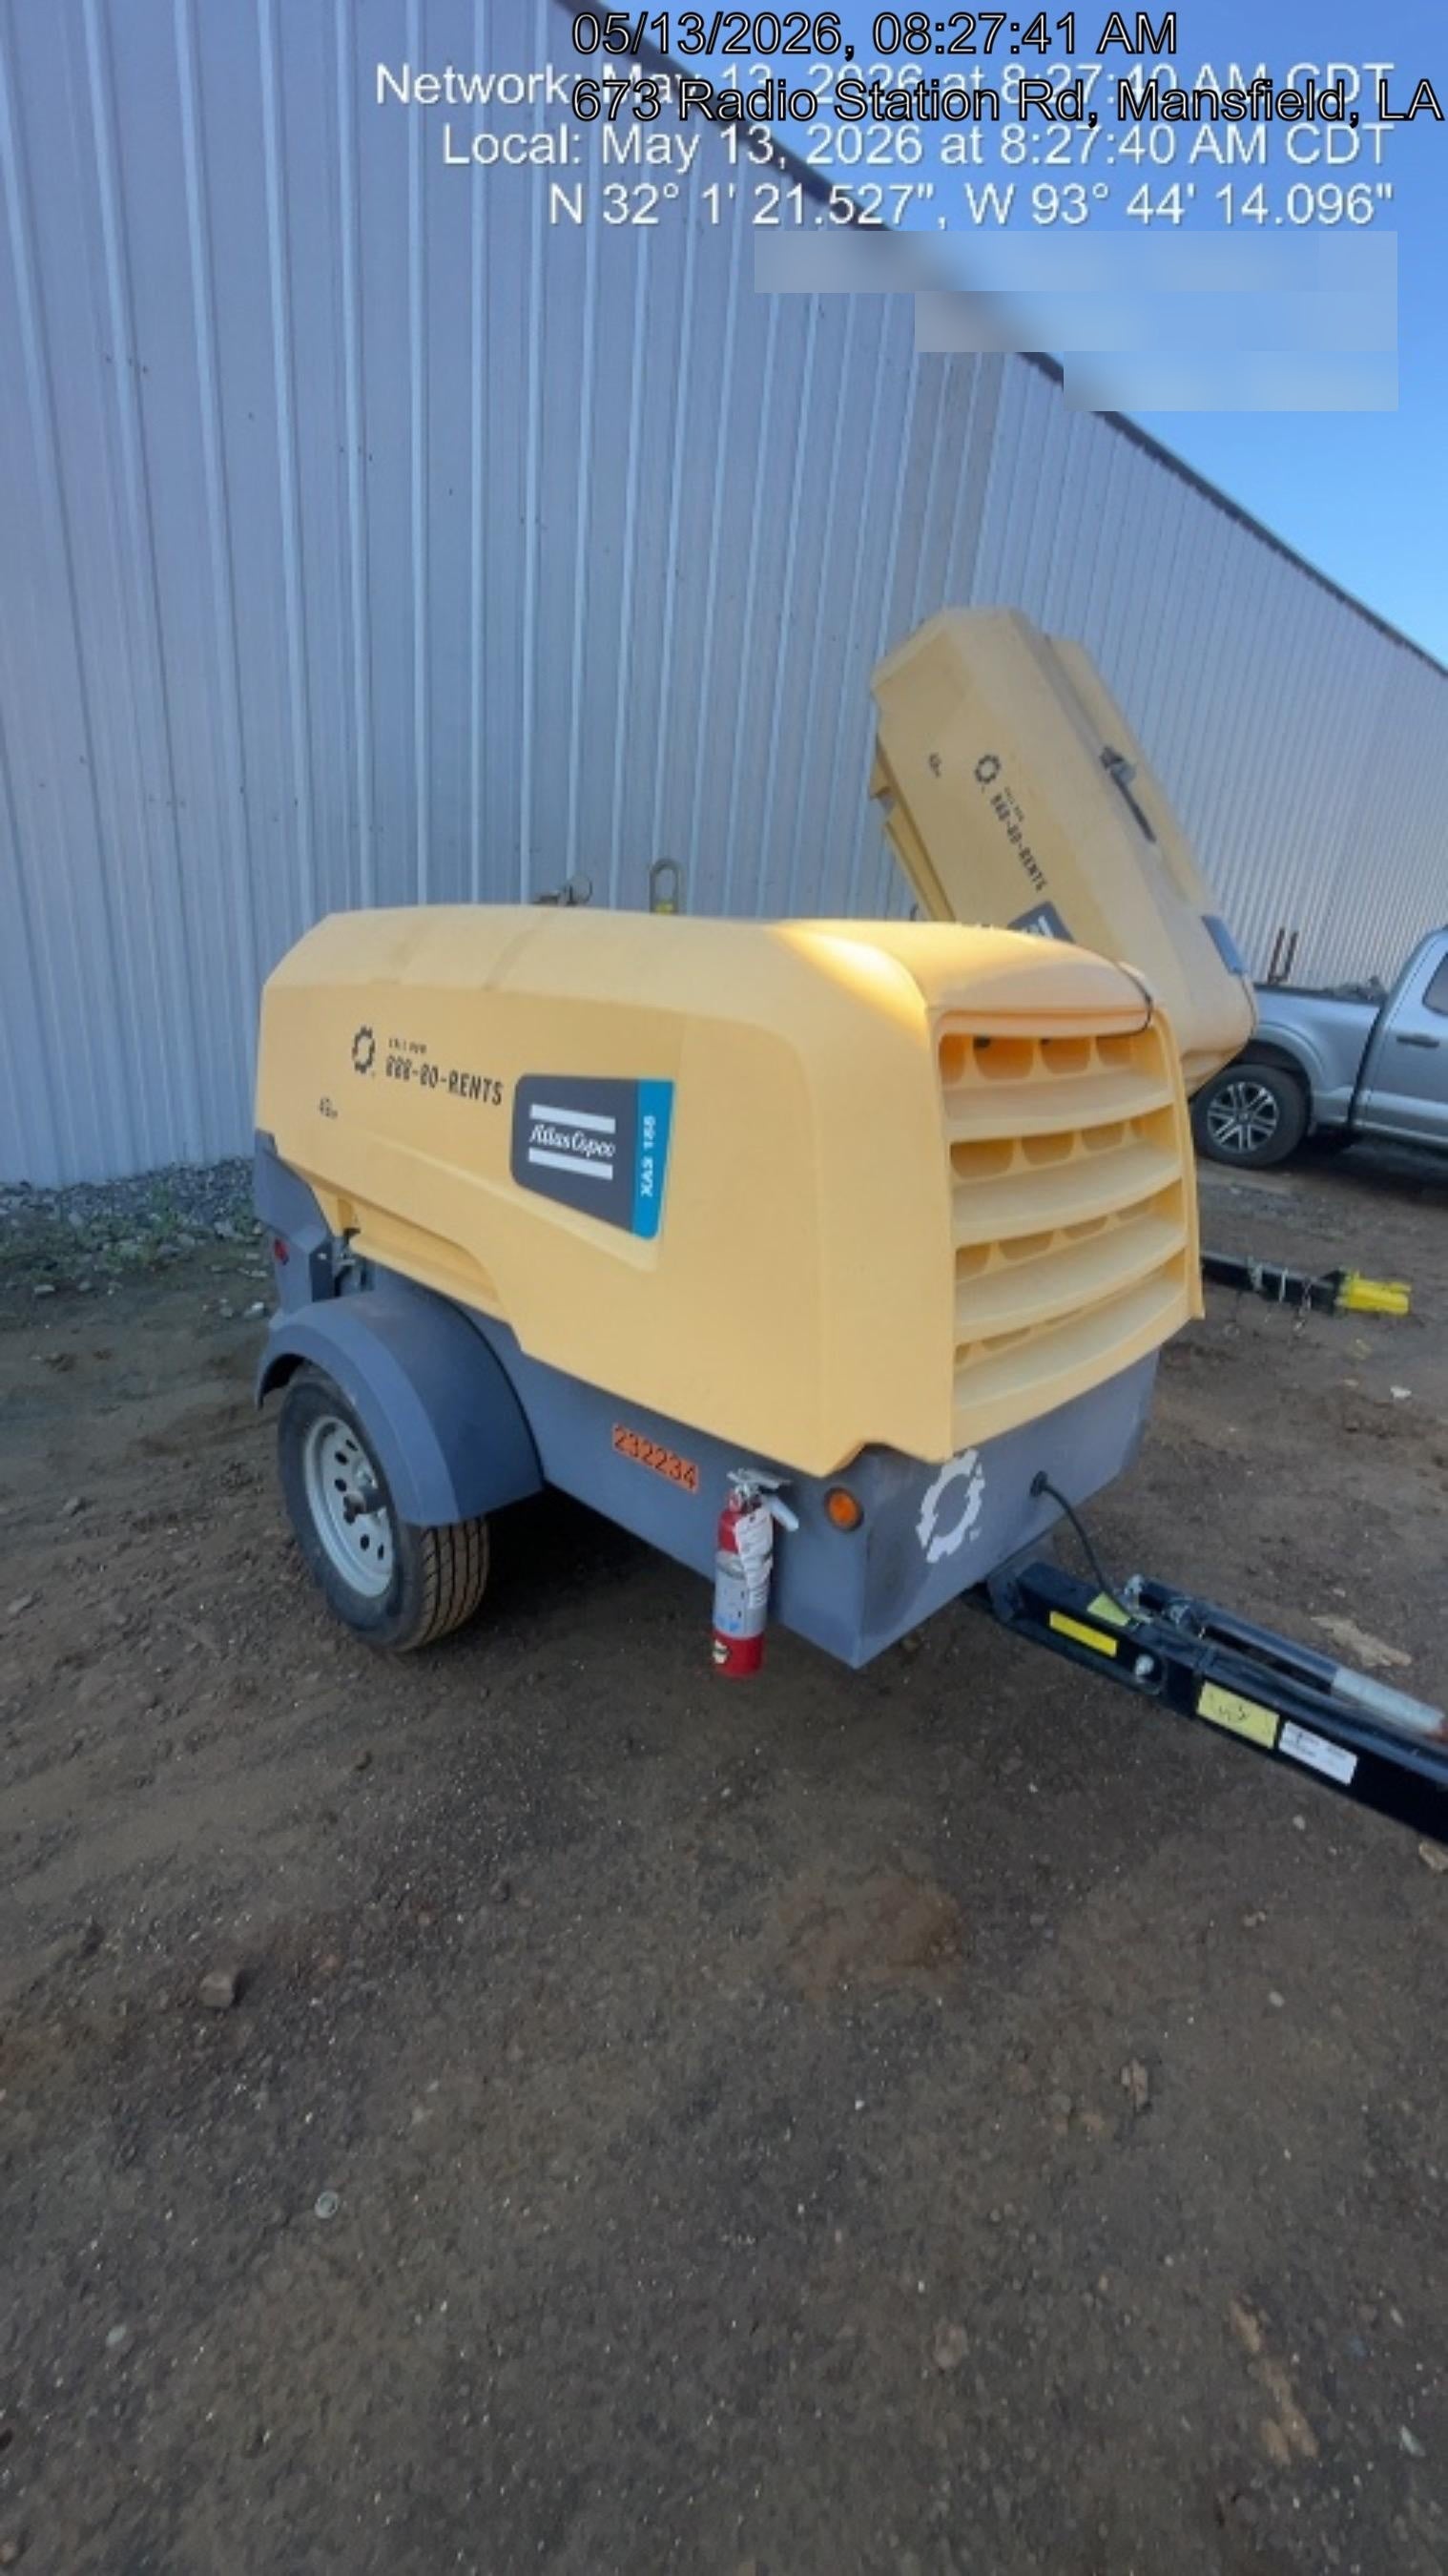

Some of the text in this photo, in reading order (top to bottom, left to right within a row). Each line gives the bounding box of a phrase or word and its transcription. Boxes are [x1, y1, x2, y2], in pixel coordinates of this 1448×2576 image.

[528, 1123, 616, 1158] Atlas Copco
[640, 1157, 654, 1197] XAS
[613, 1424, 697, 1490] 232234
